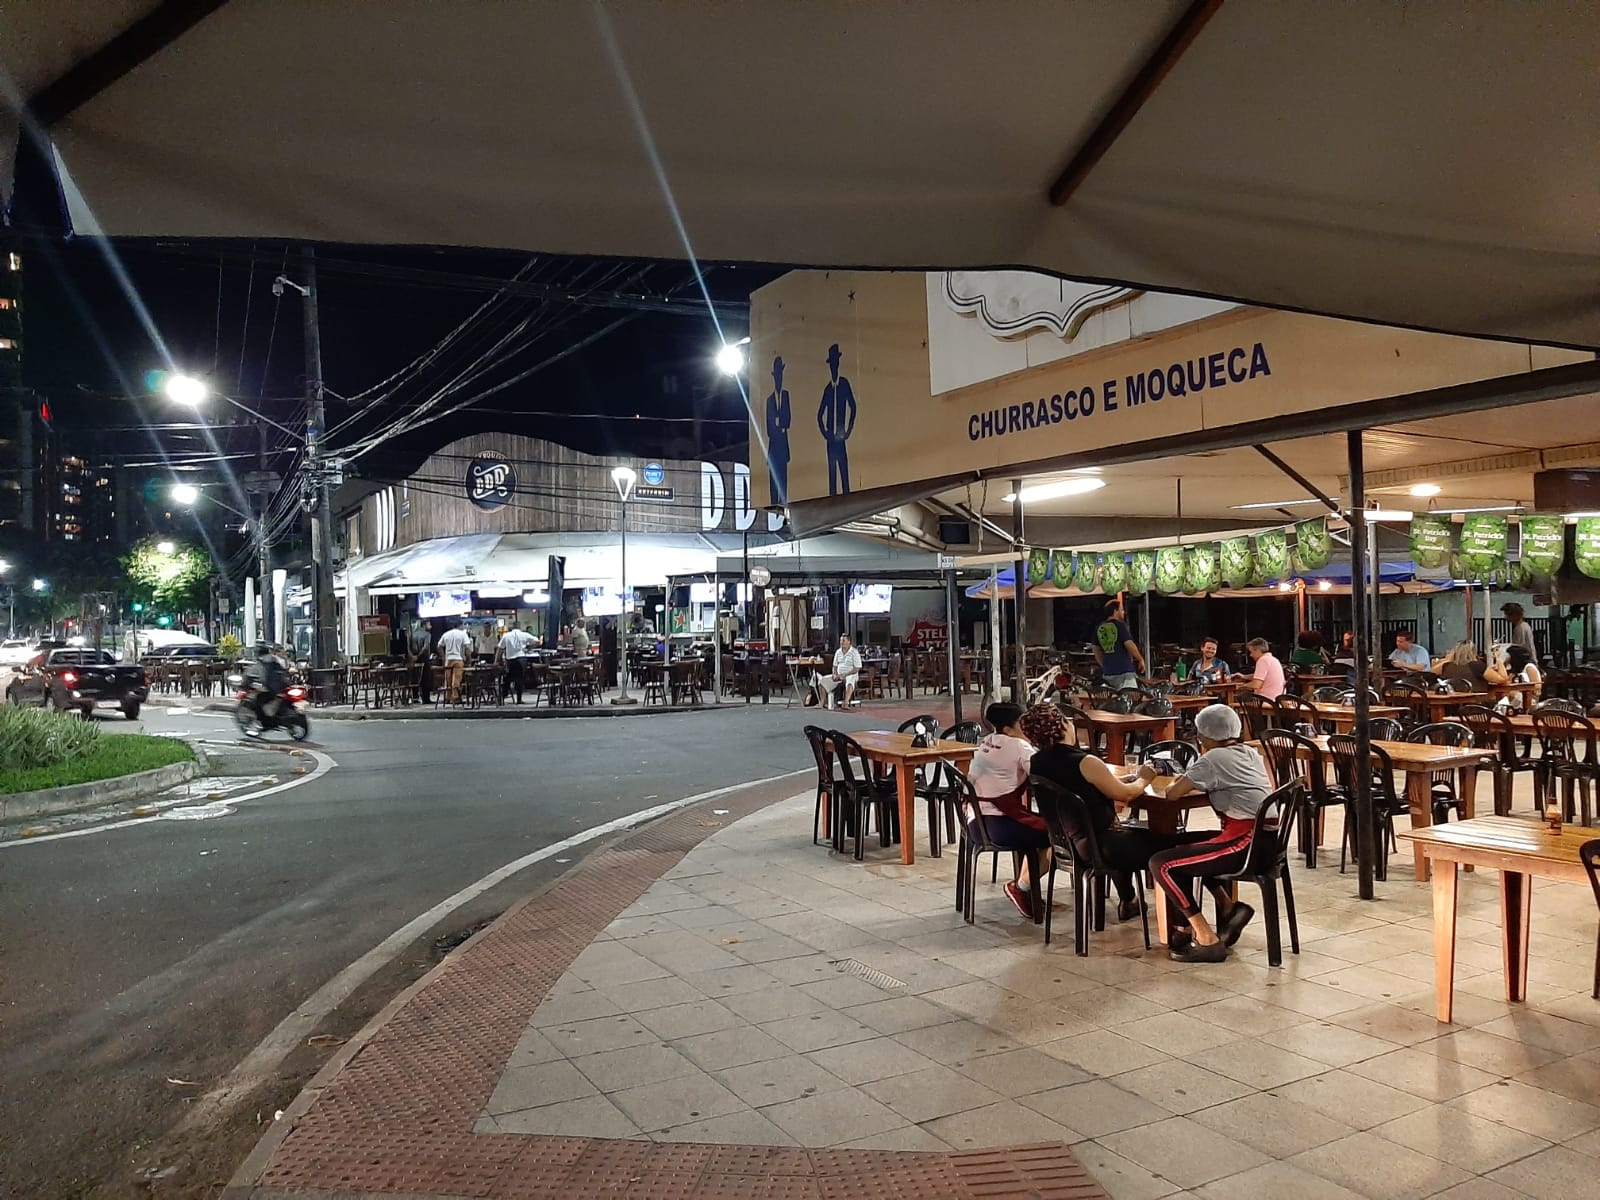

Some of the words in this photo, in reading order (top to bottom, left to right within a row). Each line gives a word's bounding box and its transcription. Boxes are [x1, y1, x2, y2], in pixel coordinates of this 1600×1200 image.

[968, 386, 1095, 441] CHURRASCO
[1103, 380, 1118, 412] E
[1125, 342, 1271, 407] MOQUECA
[917, 628, 948, 640] STEL
